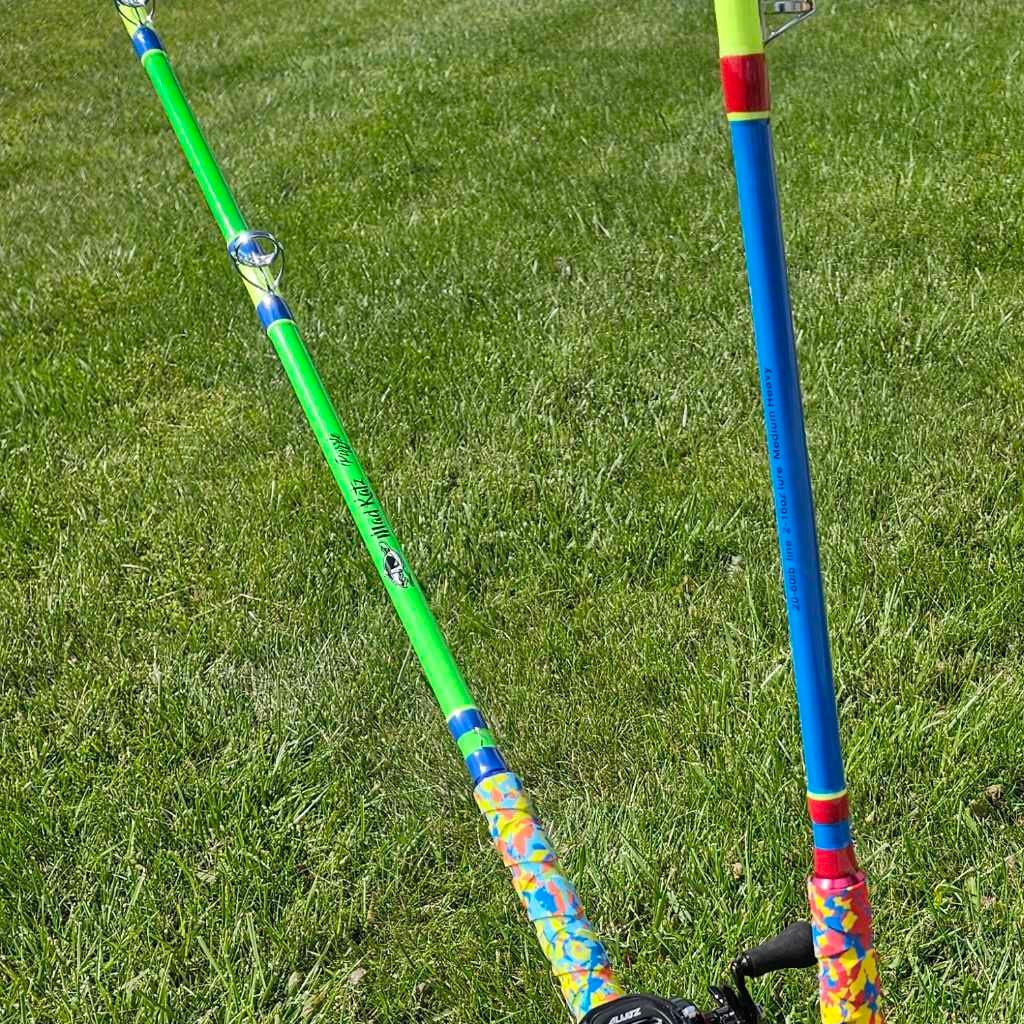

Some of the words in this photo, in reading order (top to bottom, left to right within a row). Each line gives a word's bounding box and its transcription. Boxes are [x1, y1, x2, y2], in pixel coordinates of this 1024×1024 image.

[764, 367, 776, 407] Heavy
[769, 411, 781, 460] Medium
[351, 478, 374, 507] Katz
[784, 540, 793, 561] line
